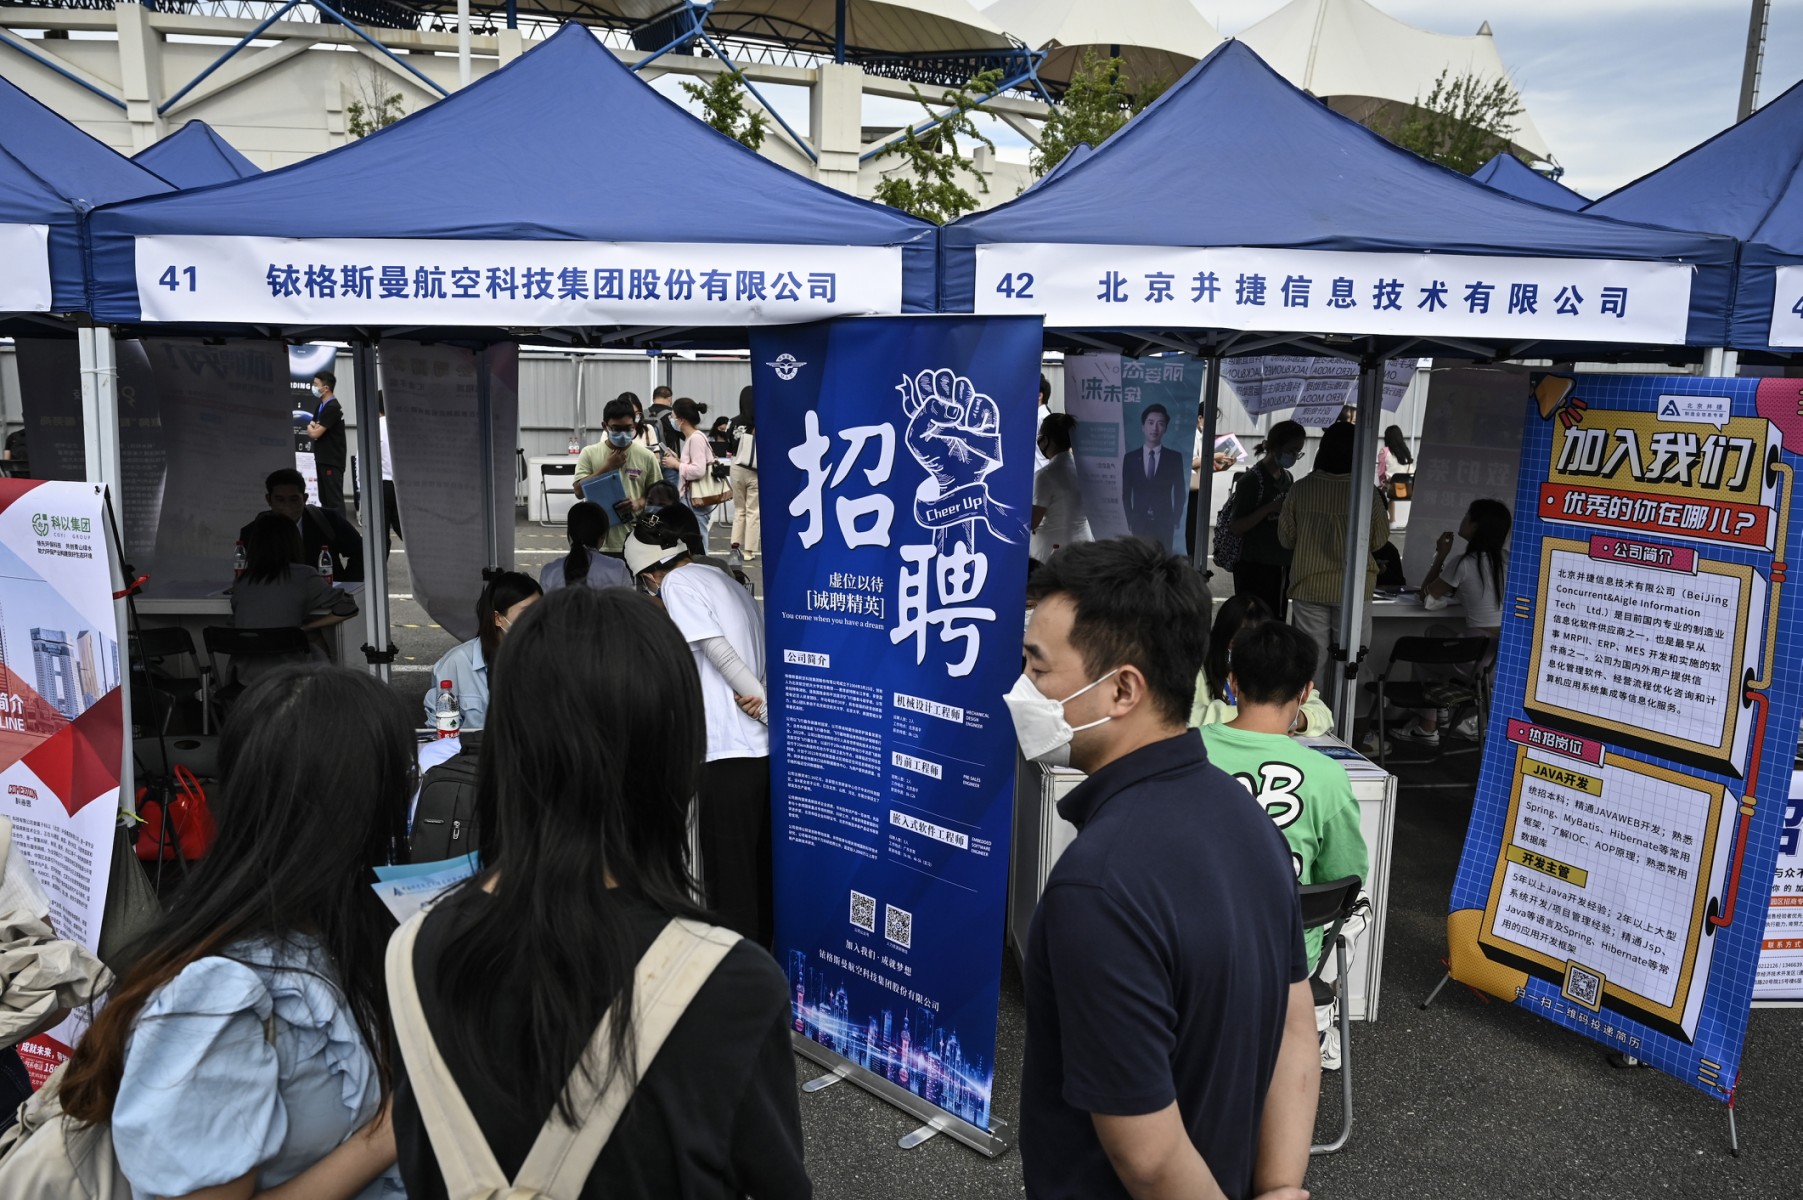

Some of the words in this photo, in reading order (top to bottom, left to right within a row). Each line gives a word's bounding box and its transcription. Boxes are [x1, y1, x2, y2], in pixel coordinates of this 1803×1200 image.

[158, 264, 197, 293] 41
[266, 263, 837, 303] 铱格斯曼航空科技集团股份有限公司
[996, 272, 1035, 299] 42
[1096, 270, 1628, 319] 北京并捷信息技术有限公司
[1556, 425, 1757, 491] 加入我们
[926, 501, 961, 522] Cheer
[962, 495, 984, 511] Up
[51, 515, 91, 533] 科以集团
[787, 409, 896, 549] 招
[889, 540, 996, 677] 聘
[1613, 541, 1674, 565] 公司简介
[829, 571, 884, 594] 虚位以待
[806, 589, 885, 619] [诚聘精英]
[1555, 600, 1576, 611] Tech
[1640, 599, 1701, 618] Information
[781, 611, 794, 620] You
[795, 613, 812, 622] come
[813, 614, 831, 624] when
[831, 617, 844, 626] you
[844, 617, 860, 628] have
[864, 620, 885, 631] dream
[1552, 614, 1706, 653] 信息化软件供应商之一，也是最早从
[787, 651, 827, 666] 公司简介
[1550, 644, 1702, 686] 件商之一。公司为国内外用户提供信
[1551, 629, 1560, 639] 事
[1648, 649, 1721, 673] 开发和实施的软
[1546, 673, 1682, 715] 算机应用系统集成等信息化服务。
[1548, 659, 1717, 706] 息化管理软件、经营流程优化咨询和计
[896, 694, 961, 721] 机械设计工程师
[1529, 727, 1583, 756] 热招岗位
[895, 753, 939, 777] 售前工程师
[1533, 764, 1589, 791] JAVA开发
[892, 812, 965, 847] 嵌入式软件工程师
[1520, 831, 1548, 848] 数据库
[1522, 852, 1571, 880] 开发主管
[1501, 918, 1577, 955] 用的应用开发框架
[1767, 941, 1801, 949] 联系方式
[818, 948, 940, 1013] 铱格斯曼航空科技集团股份有限公司
[1515, 986, 1641, 1050] 扫一扫二维码投递简历
